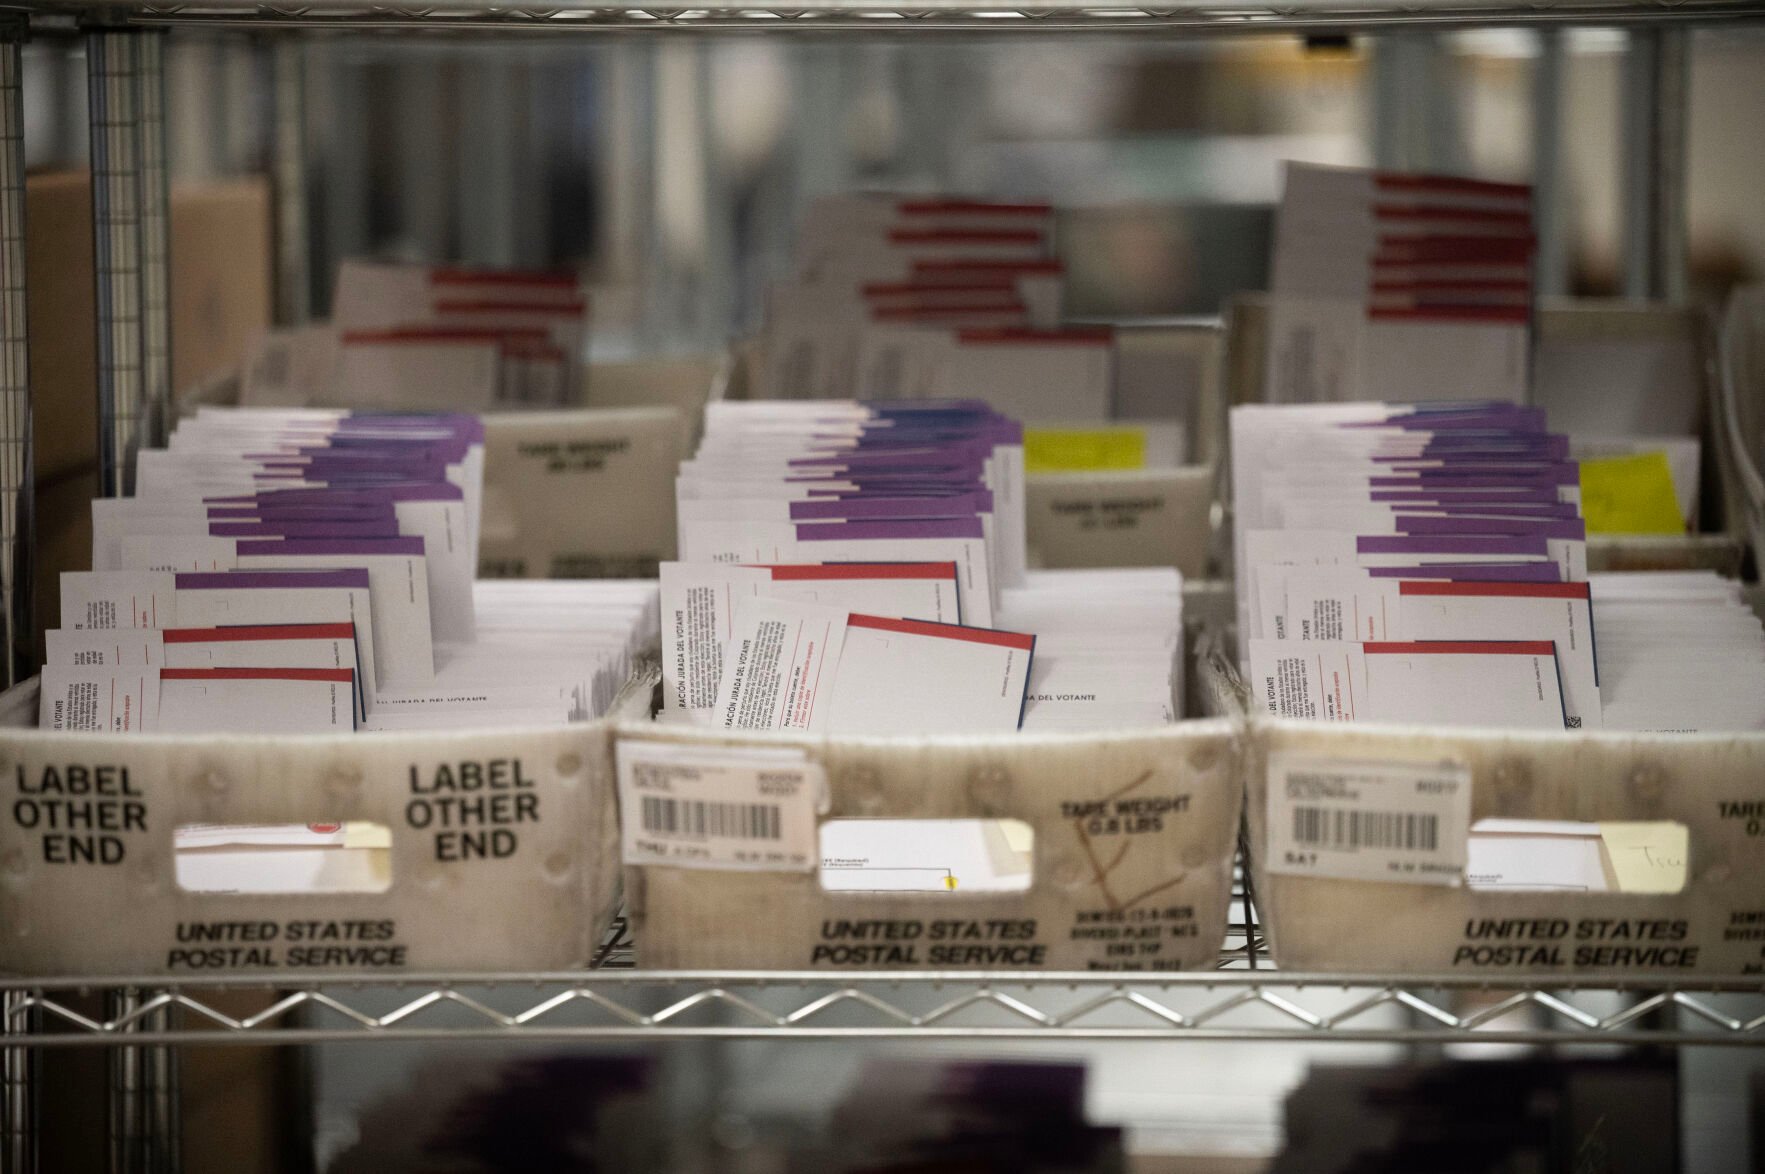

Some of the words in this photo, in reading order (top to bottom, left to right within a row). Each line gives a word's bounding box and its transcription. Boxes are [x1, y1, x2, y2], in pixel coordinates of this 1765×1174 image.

[675, 610, 683, 637] VOTANTE
[676, 640, 684, 651] DEL
[738, 638, 750, 666] VOTANTE
[676, 653, 685, 678] JURADA
[735, 665, 745, 676] DEL
[730, 676, 742, 701] JURADA
[1038, 694, 1053, 702] DEL
[1056, 694, 1097, 702] VOTANTE
[1266, 676, 1275, 700] VOTANTE
[54, 700, 63, 722] VOTANTE
[1268, 700, 1276, 711] DEL
[17, 766, 142, 797] LABEL
[409, 759, 534, 794] LABEL
[406, 794, 538, 828] OTHER
[1116, 794, 1191, 815] WEIGHT
[14, 802, 147, 832] OTHER
[1123, 816, 1164, 834] LBS
[43, 835, 126, 865] END
[436, 829, 517, 861] END
[176, 921, 278, 943] UNITED
[285, 920, 394, 942] STATES
[821, 920, 922, 941] UNITED
[927, 919, 1036, 940] STATES
[1465, 920, 1570, 941] UNITED
[1575, 919, 1687, 941] STATES
[167, 948, 278, 969] POSTAL
[285, 946, 406, 967] SERVICE
[811, 945, 919, 966] POSTAL
[926, 944, 1045, 965] SERVICE
[1453, 946, 1571, 967] POSTAL
[1575, 946, 1698, 966] SERVICE
